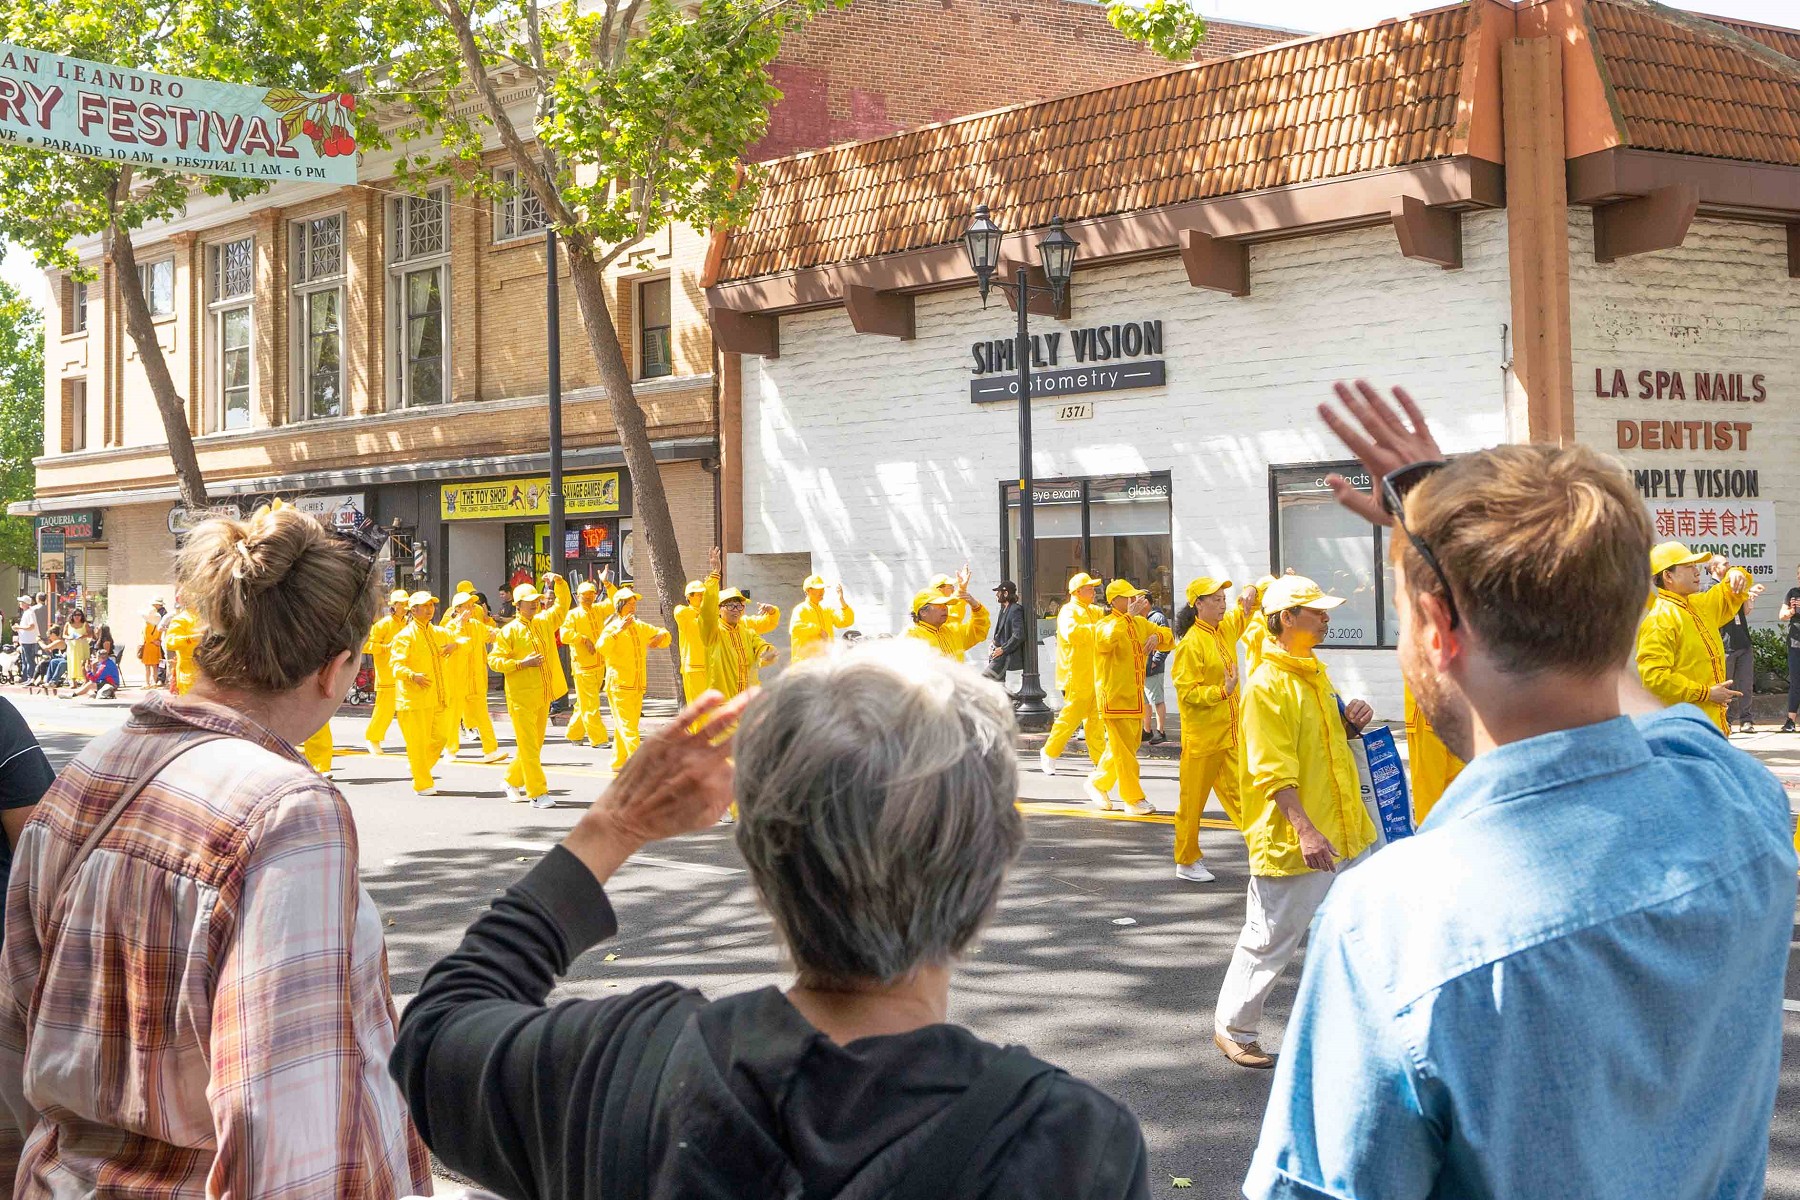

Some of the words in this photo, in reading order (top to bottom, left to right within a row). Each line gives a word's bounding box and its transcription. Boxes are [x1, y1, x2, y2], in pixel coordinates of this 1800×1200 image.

[1, 52, 39, 74] AN
[56, 62, 184, 99] LEANDRO
[0, 75, 64, 130] RY
[77, 90, 300, 159] FESTIVAL
[42, 136, 103, 157] PARADE
[109, 148, 127, 160] 10
[130, 151, 154, 164] AM
[175, 156, 237, 173] FESTIVAL
[241, 162, 256, 174] 11
[260, 164, 282, 175] AM
[294, 166, 302, 177] 6
[305, 167, 326, 179] PM
[1070, 319, 1163, 363] VISION
[1595, 367, 1630, 399] LA
[1637, 369, 1687, 401] SPA
[1694, 372, 1768, 403] NAILS
[1060, 405, 1086, 419] 1371
[1616, 419, 1753, 451] DENTIST
[563, 483, 583, 499] SAVAGE
[583, 481, 601, 498] GAMES
[1315, 473, 1370, 488] coacts
[1629, 469, 1687, 499] MPLY
[1694, 469, 1760, 499] VISION
[462, 490, 474, 505] THE
[475, 489, 489, 504] TOY
[489, 487, 507, 503] SHOP
[1032, 491, 1050, 504] eye
[1052, 488, 1081, 500] exam
[1127, 484, 1168, 499] glasses
[40, 515, 75, 527] TAQUERIA
[77, 514, 87, 523] #5
[340, 511, 357, 524] SHO
[1655, 507, 1759, 538] 嶺南美食坊
[582, 527, 607, 549] TOY
[512, 551, 533, 569] HULK
[1690, 543, 1729, 559] KONG
[1731, 543, 1766, 559] CHEF
[535, 552, 552, 572] MAS
